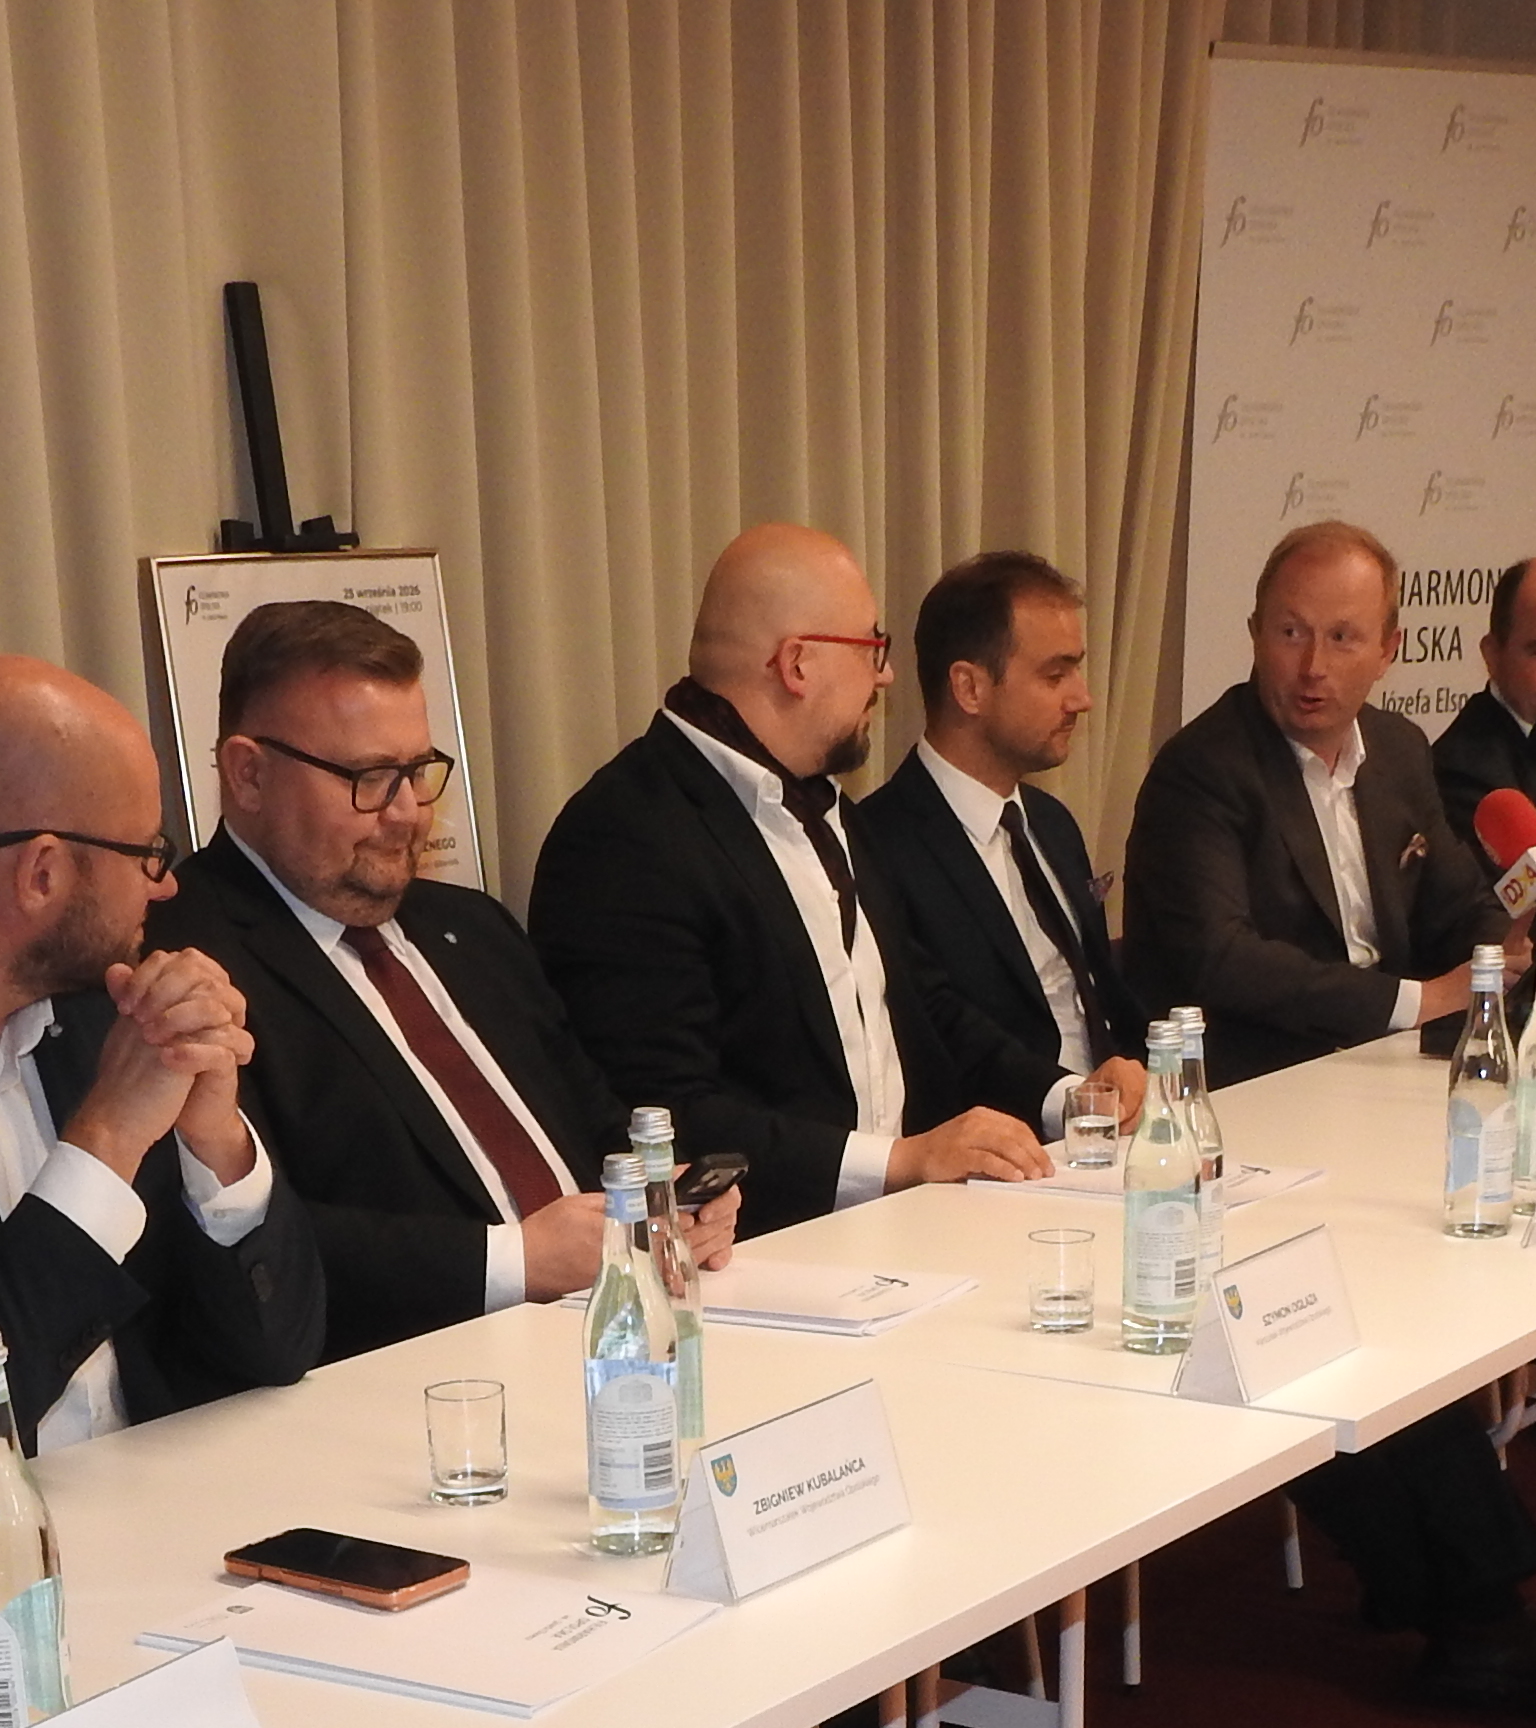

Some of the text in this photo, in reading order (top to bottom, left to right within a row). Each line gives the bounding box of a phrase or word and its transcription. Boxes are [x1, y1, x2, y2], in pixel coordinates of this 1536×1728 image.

[356, 585, 396, 599] września
[1391, 626, 1463, 664] LSKA
[752, 1457, 866, 1515] ZBIGNIEW KUBALAŃCA
